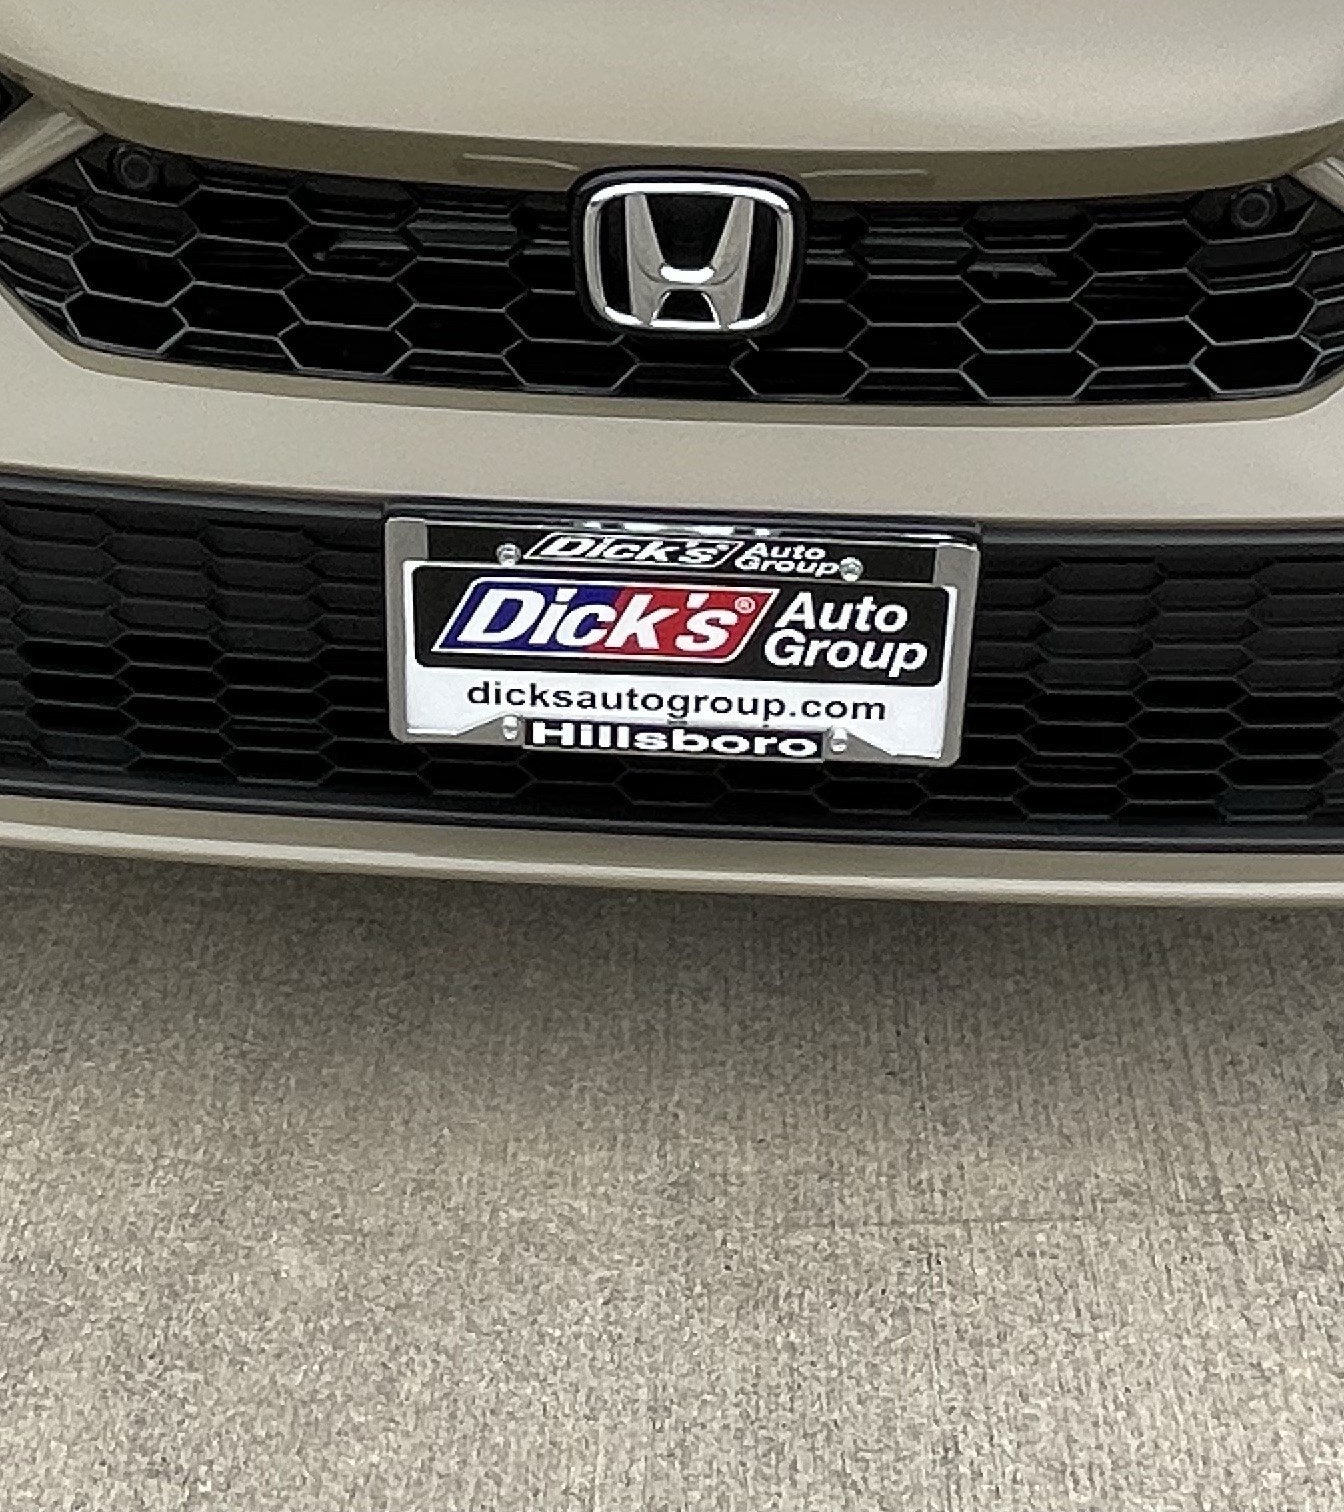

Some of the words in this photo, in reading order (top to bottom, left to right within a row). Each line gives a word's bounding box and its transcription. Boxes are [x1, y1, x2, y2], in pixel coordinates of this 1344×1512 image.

[538, 535, 718, 565] Dick's
[734, 555, 840, 577] Group
[745, 541, 826, 561] Auto
[457, 587, 739, 653] Dick's
[775, 591, 908, 634] Auto
[763, 628, 928, 678] Group
[466, 680, 886, 721] dicksautogroup.com
[531, 721, 818, 758] Hillsboro
